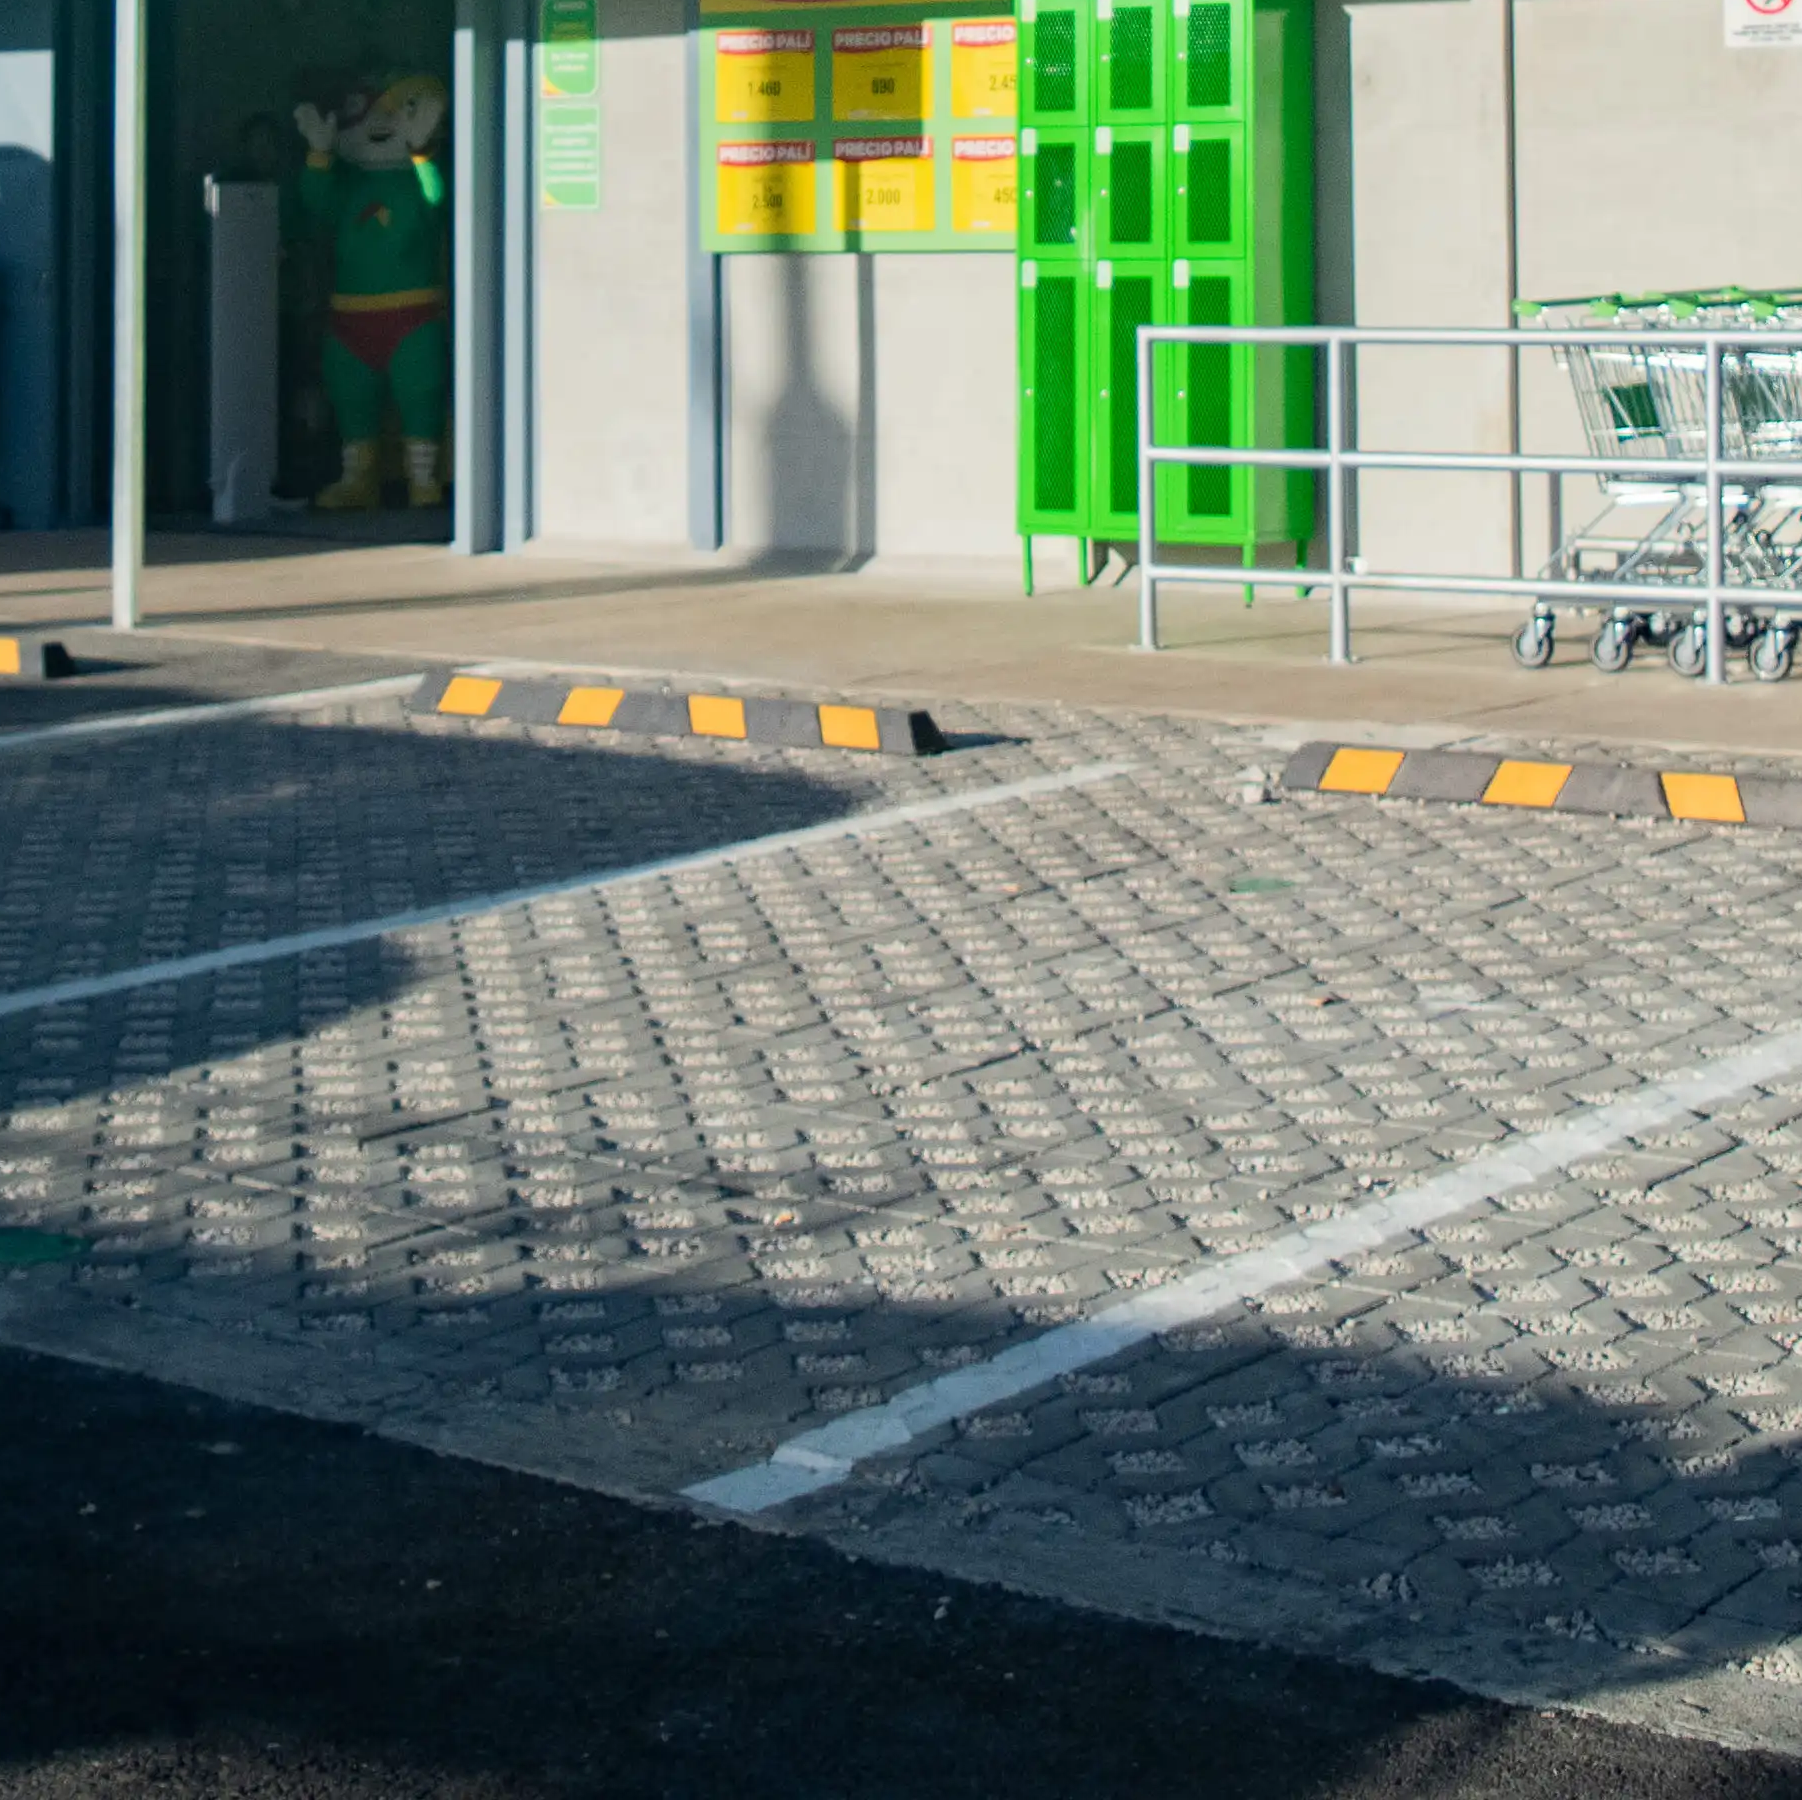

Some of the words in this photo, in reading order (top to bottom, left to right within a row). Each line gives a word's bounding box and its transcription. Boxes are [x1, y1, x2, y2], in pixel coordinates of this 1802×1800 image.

[834, 30, 893, 47] PRECIO
[954, 25, 1015, 43] PRECIO
[834, 140, 893, 157] PRECIO
[954, 138, 1015, 157] PRECIO
